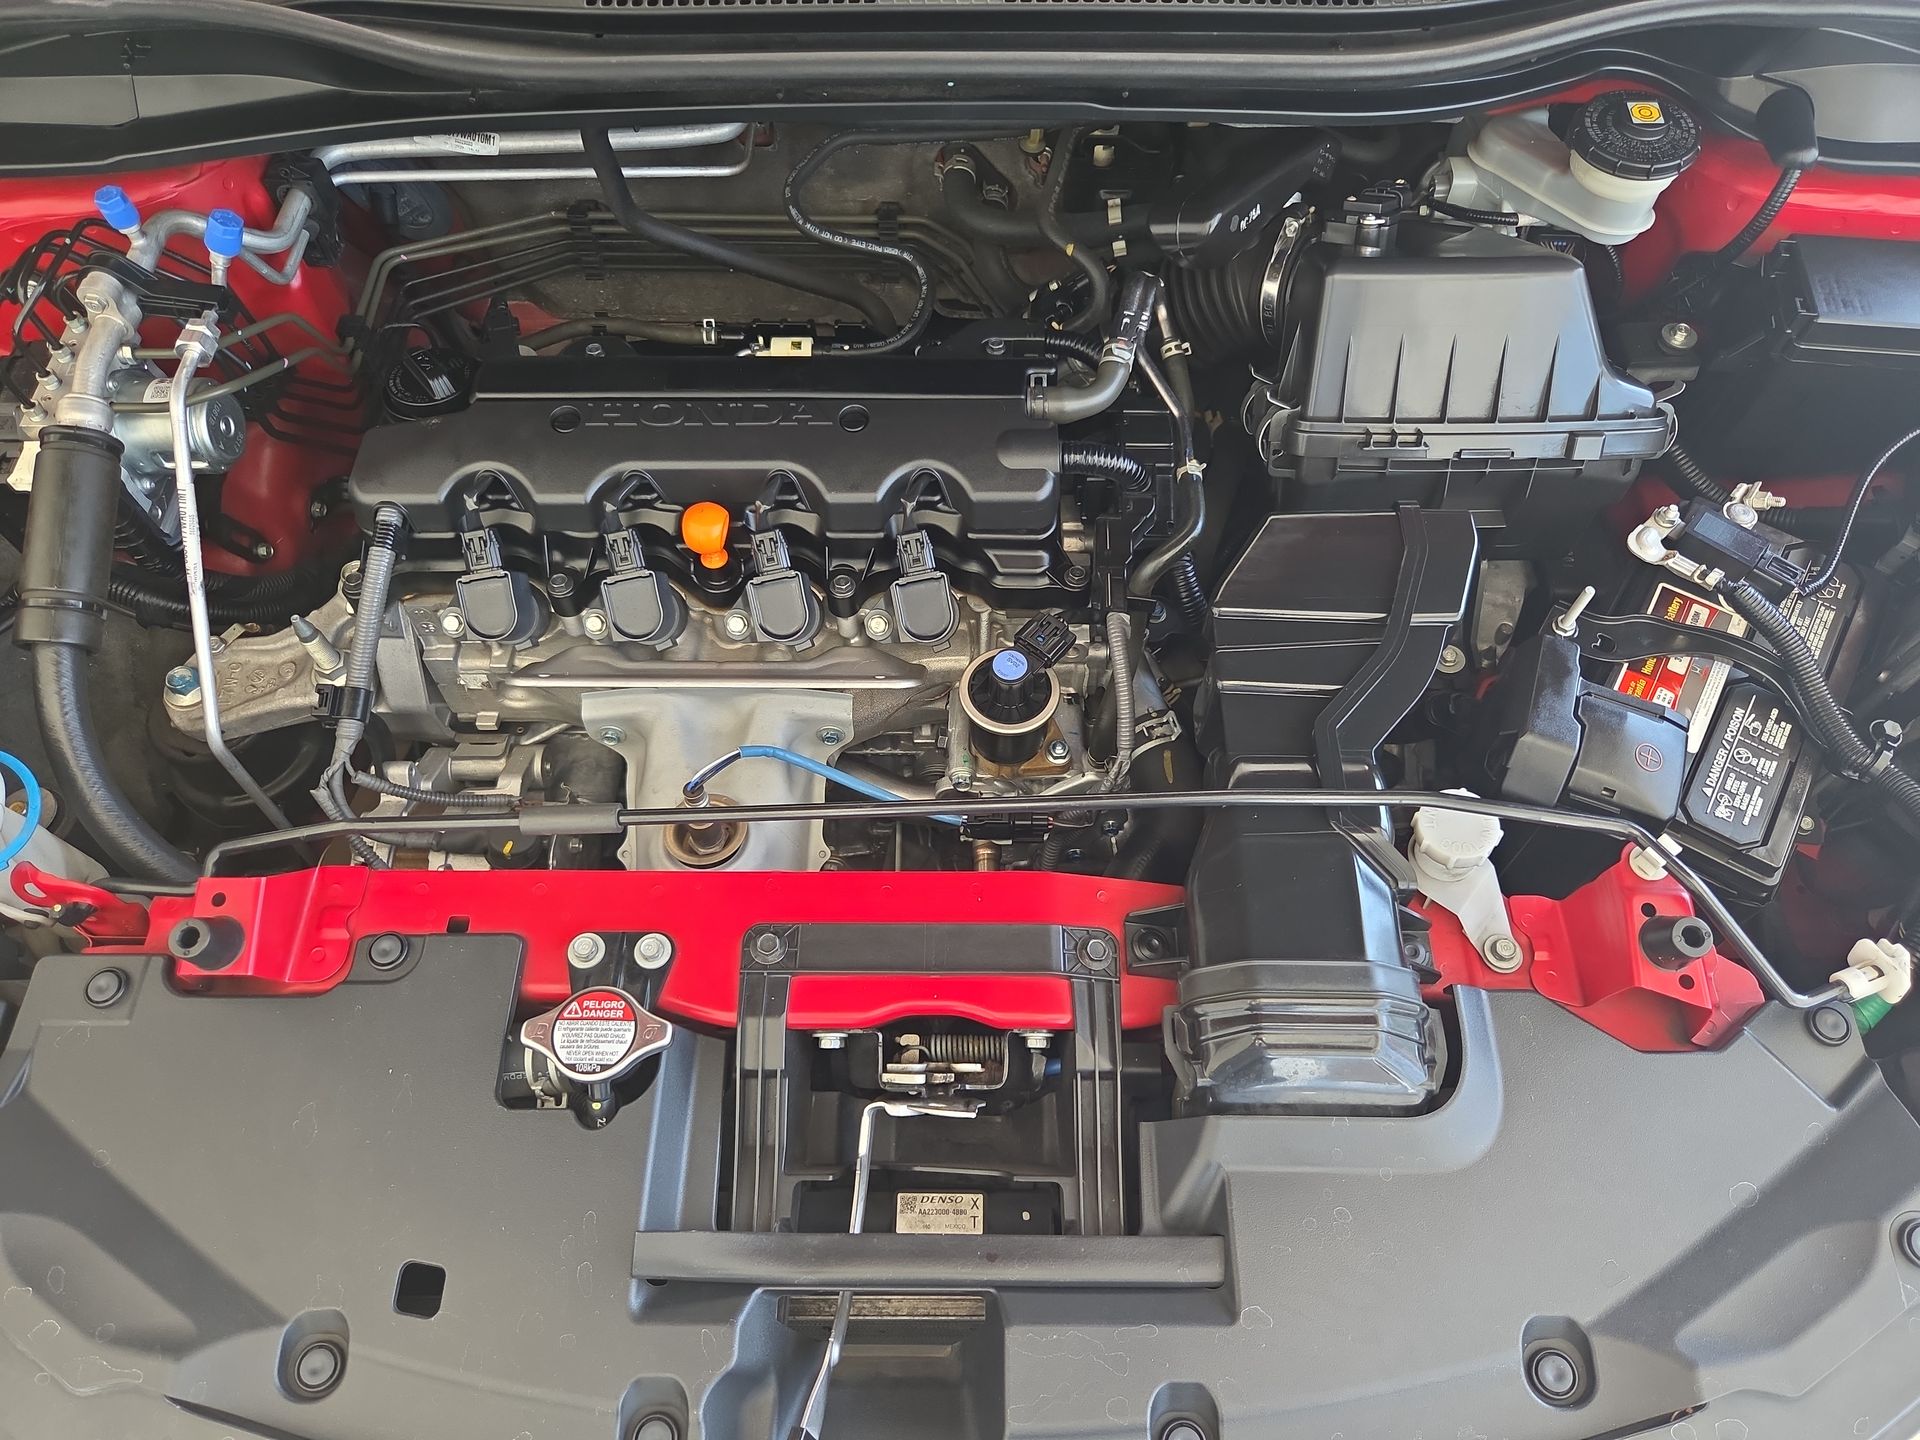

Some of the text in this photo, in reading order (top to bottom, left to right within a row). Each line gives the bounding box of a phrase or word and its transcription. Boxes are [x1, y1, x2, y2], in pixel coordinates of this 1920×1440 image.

[584, 403, 834, 426] HONDA
[1705, 748, 1728, 787] DANGER
[1724, 707, 1745, 742] POISON
[583, 1000, 625, 1009] PELIGRO
[583, 1010, 623, 1018] DANGER
[575, 1064, 601, 1072] 108kPa
[971, 1198, 979, 1210] X
[970, 1216, 979, 1228] T
